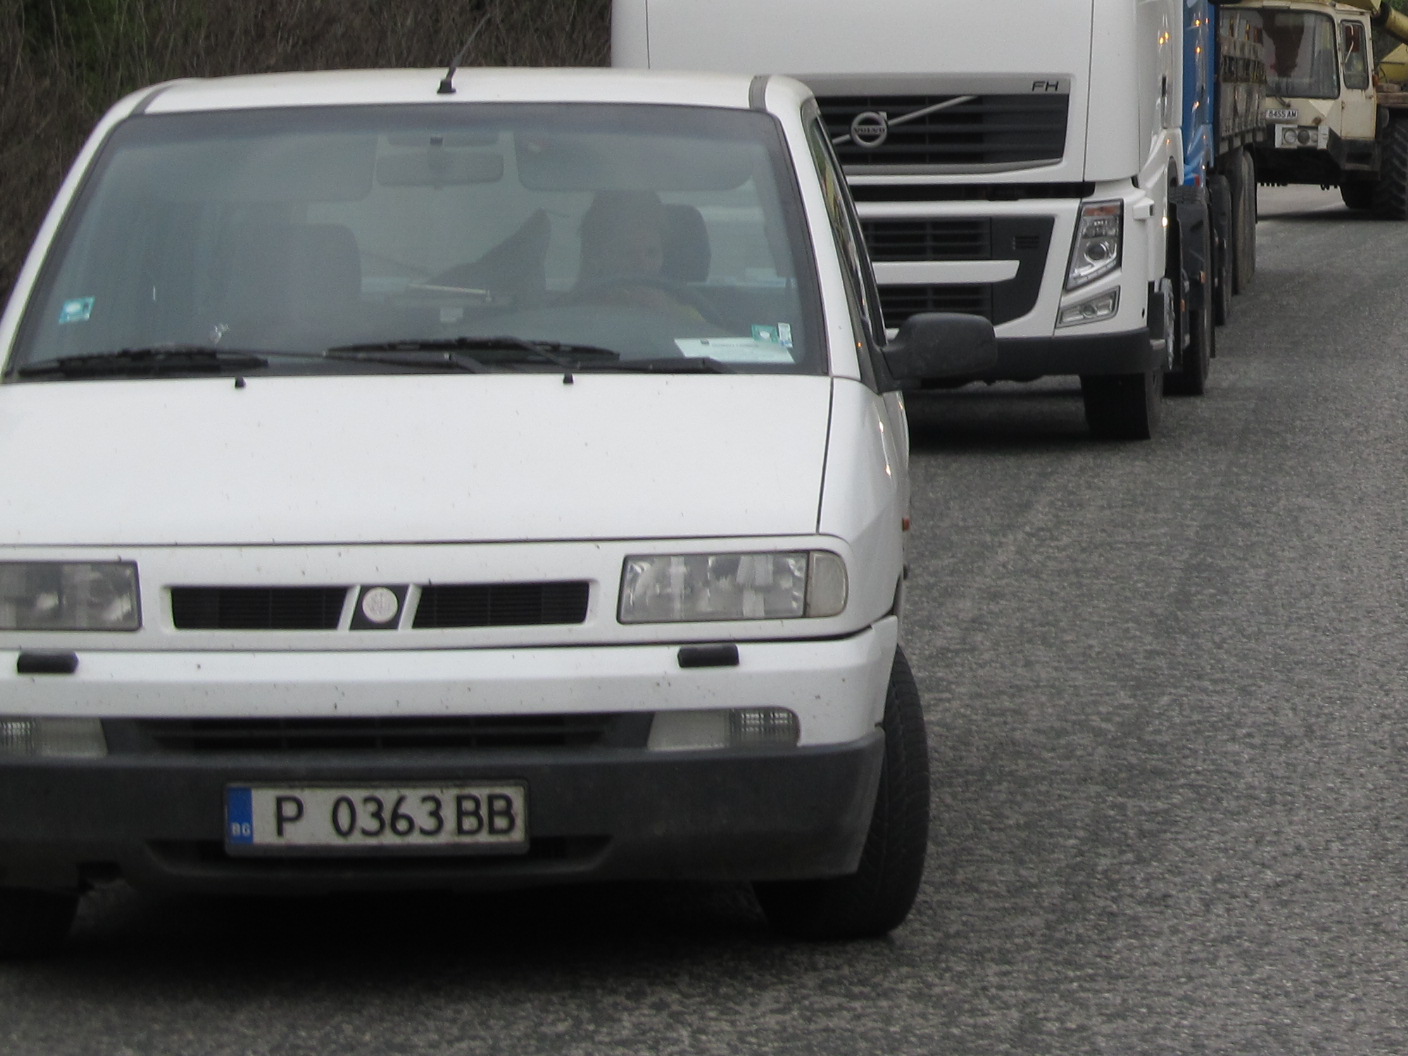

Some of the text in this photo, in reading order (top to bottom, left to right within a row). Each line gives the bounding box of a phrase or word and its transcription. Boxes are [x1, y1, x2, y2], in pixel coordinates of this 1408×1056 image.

[1031, 80, 1059, 92] FH
[853, 126, 886, 135] VOLVO
[274, 795, 304, 837] P
[231, 822, 250, 837] BG
